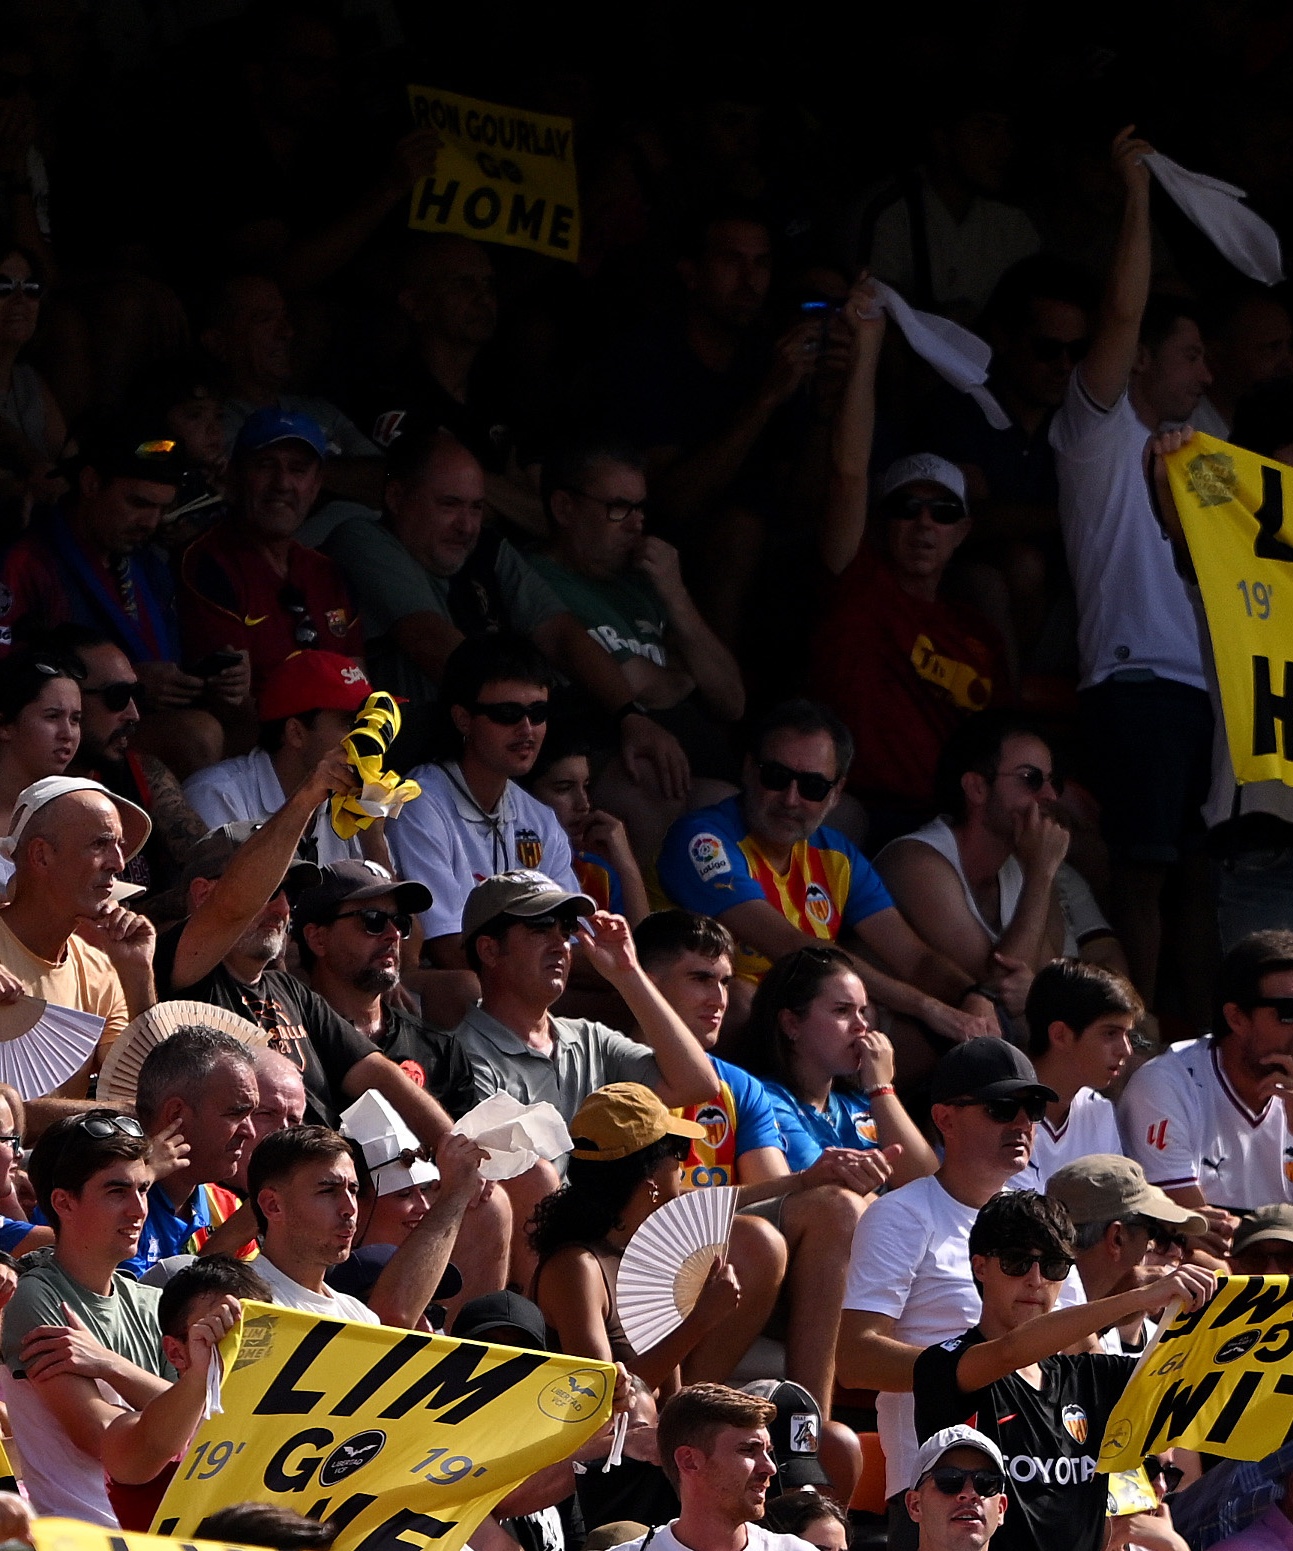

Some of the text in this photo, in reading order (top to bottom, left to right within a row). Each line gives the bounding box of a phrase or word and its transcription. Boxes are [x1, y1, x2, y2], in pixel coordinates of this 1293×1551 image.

[417, 178, 573, 249] HOME
[1236, 579, 1274, 621] 19'
[253, 1321, 551, 1426] LIM
[550, 1386, 582, 1412] LIBERTAD
[185, 1440, 246, 1481] 19'
[263, 1427, 387, 1493] GO
[410, 1447, 490, 1487] 19'
